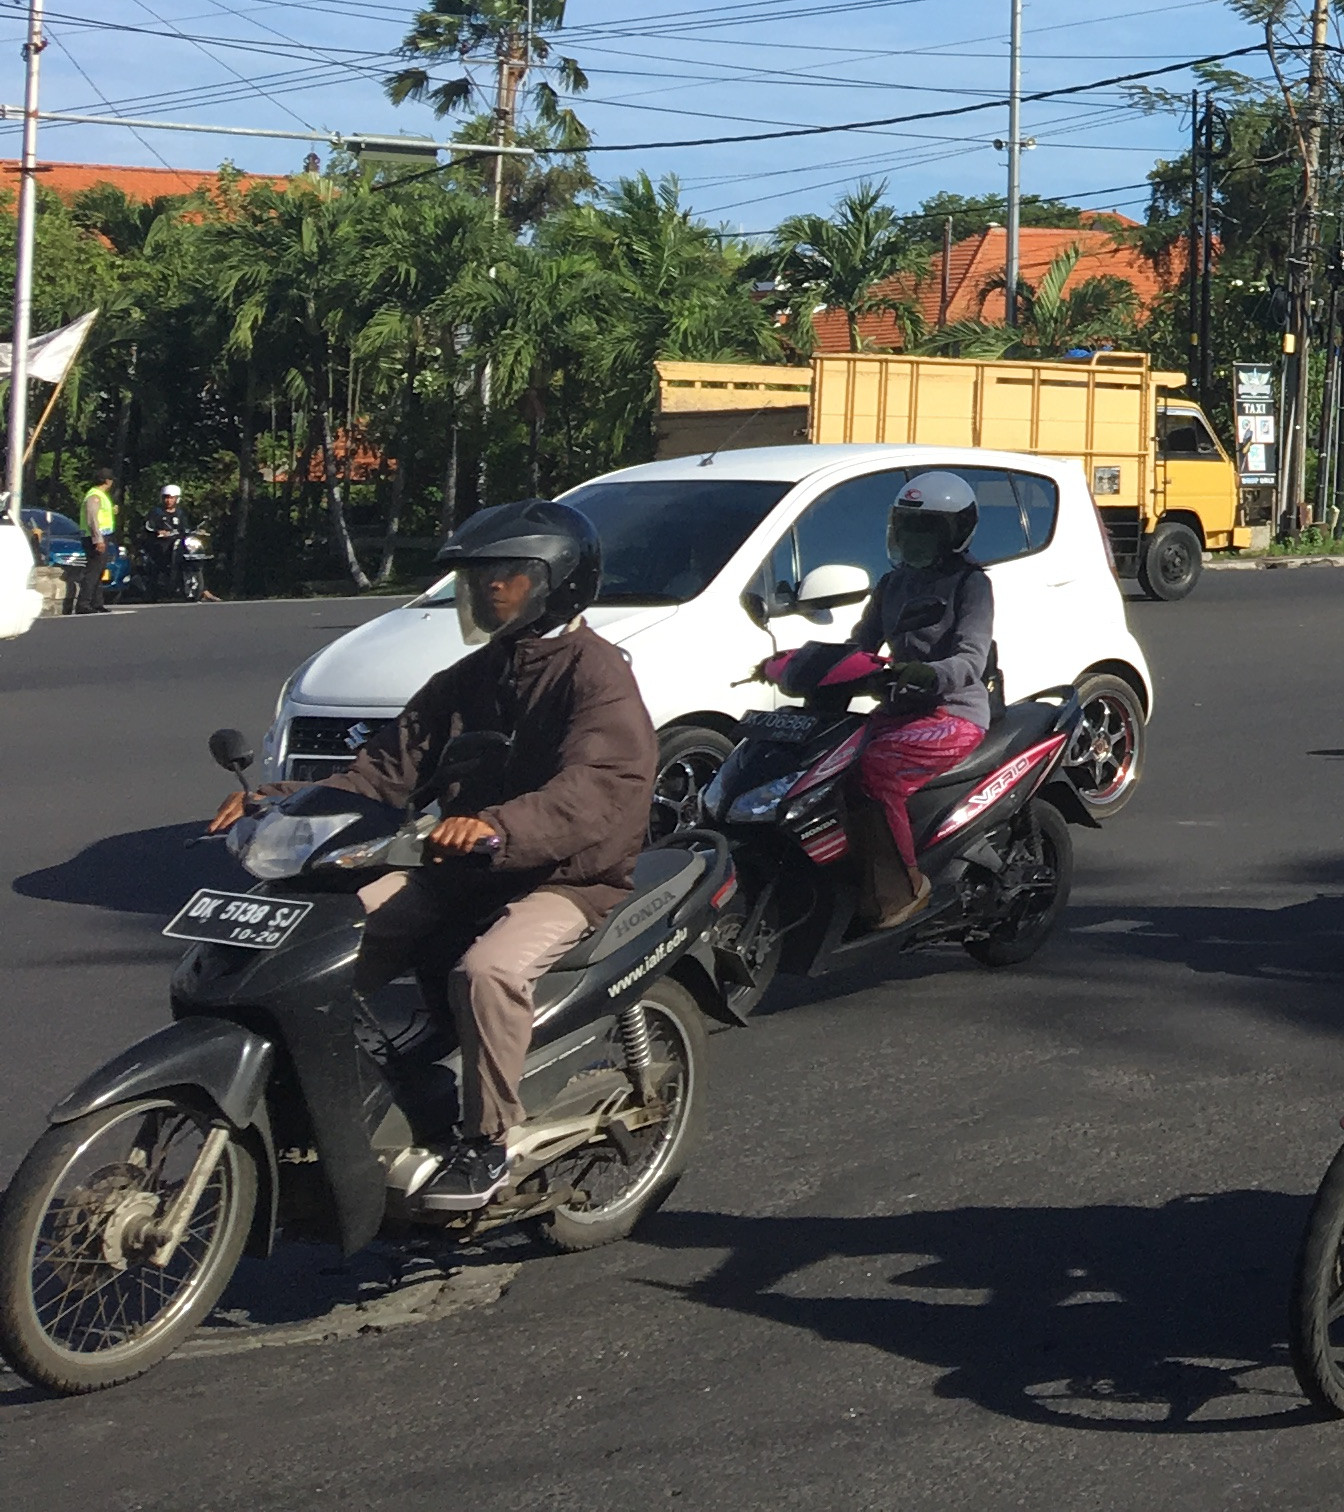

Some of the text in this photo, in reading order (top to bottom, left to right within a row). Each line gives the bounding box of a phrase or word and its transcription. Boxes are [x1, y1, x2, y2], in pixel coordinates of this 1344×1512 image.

[1242, 402, 1267, 415] TAXI
[974, 757, 1030, 803] VARIO
[188, 897, 303, 928] DK 5138 SJ
[614, 890, 677, 938] HONDA
[607, 926, 688, 998] www.ialf.edu
